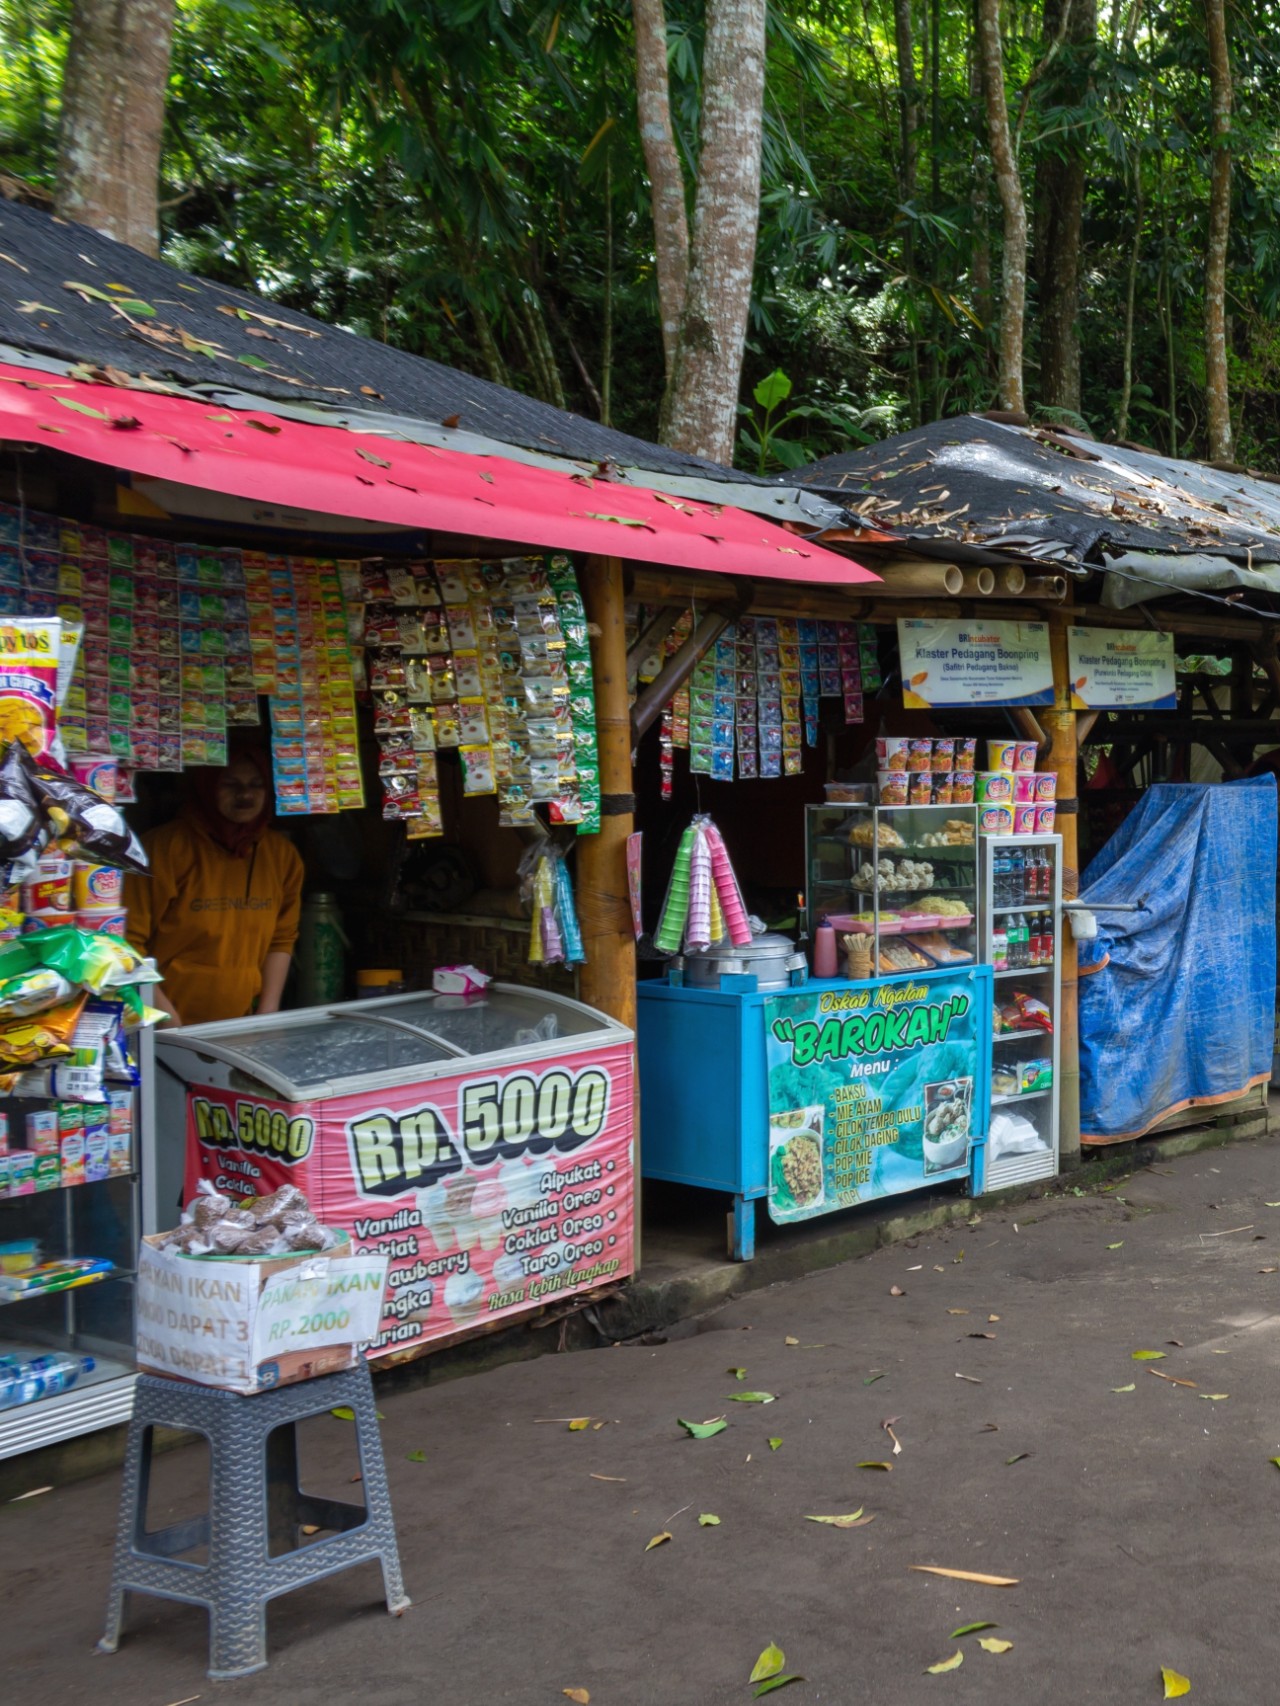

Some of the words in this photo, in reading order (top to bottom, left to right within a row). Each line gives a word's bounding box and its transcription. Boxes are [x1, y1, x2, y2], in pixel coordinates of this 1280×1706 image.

[915, 648, 949, 659] Klaster
[951, 648, 996, 661] Pedagang
[997, 649, 1039, 661] Boonpring
[966, 663, 997, 672] Pedagang
[1102, 656, 1133, 668] Pedagang
[820, 988, 870, 1013] Oskab
[874, 980, 929, 1011] Ngalam
[850, 1060, 892, 1079] Menu
[835, 1083, 866, 1103] BAKSO
[836, 1104, 853, 1120] MIE
[856, 1099, 882, 1117] AYAM
[836, 1119, 865, 1138] CILOK
[865, 1111, 897, 1131] TEMPO
[897, 1106, 921, 1124] DULU
[194, 1099, 238, 1148] Rp.
[237, 1104, 313, 1162] 5000
[350, 1108, 462, 1195] Rp.
[463, 1071, 608, 1166] 5000
[834, 1137, 863, 1155] CILOK
[864, 1128, 899, 1148] DAGING
[217, 1155, 261, 1178] Vanilla
[835, 1155, 854, 1172] POP
[856, 1151, 872, 1167] MIE
[540, 1161, 601, 1194] Alpukat
[835, 1172, 854, 1189] POP
[855, 1168, 870, 1185] ICE
[502, 1200, 558, 1228] Vanilla
[562, 1189, 601, 1211] Oreo
[837, 1189, 861, 1207] KOPI
[354, 1210, 422, 1240] Vanilla
[504, 1226, 557, 1254] Coklat
[562, 1214, 602, 1237] Oreo
[388, 1251, 469, 1288] awberry
[521, 1253, 559, 1275] Taro
[563, 1238, 603, 1262] Oreo
[188, 1277, 241, 1303] IKAN
[326, 1272, 382, 1297] IKAN
[487, 1287, 525, 1313] Rasa
[528, 1271, 563, 1303] Lebih
[564, 1257, 620, 1287] Lengkap
[383, 1288, 432, 1319] ngka
[167, 1309, 230, 1340] DAPAT
[236, 1320, 249, 1342] 3
[269, 1308, 351, 1342] RP.2000
[169, 1346, 229, 1376] DAPAT
[236, 1360, 246, 1378] 1
